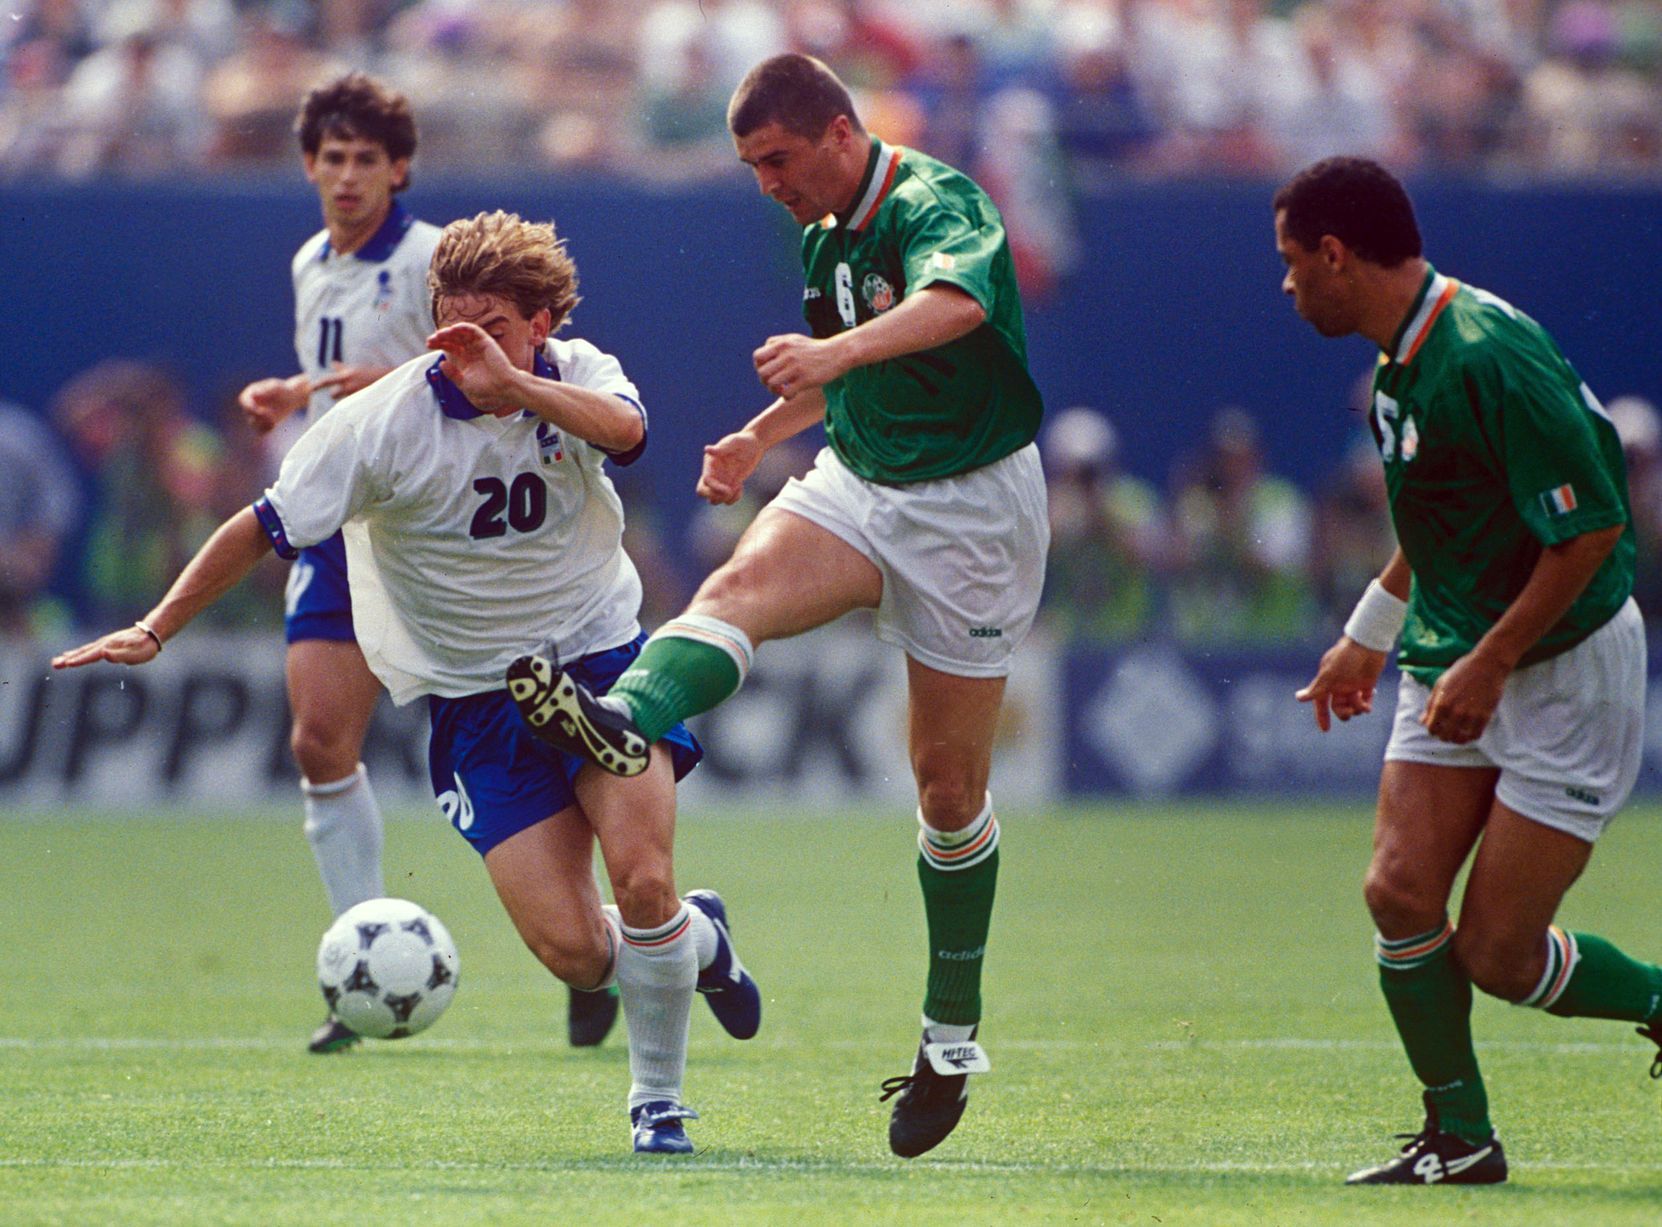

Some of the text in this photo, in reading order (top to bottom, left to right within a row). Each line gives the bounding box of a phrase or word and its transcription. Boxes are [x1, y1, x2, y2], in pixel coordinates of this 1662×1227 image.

[835, 261, 856, 327] 6
[318, 317, 344, 369] 11
[1375, 389, 1399, 463] 5
[469, 472, 547, 540] 20
